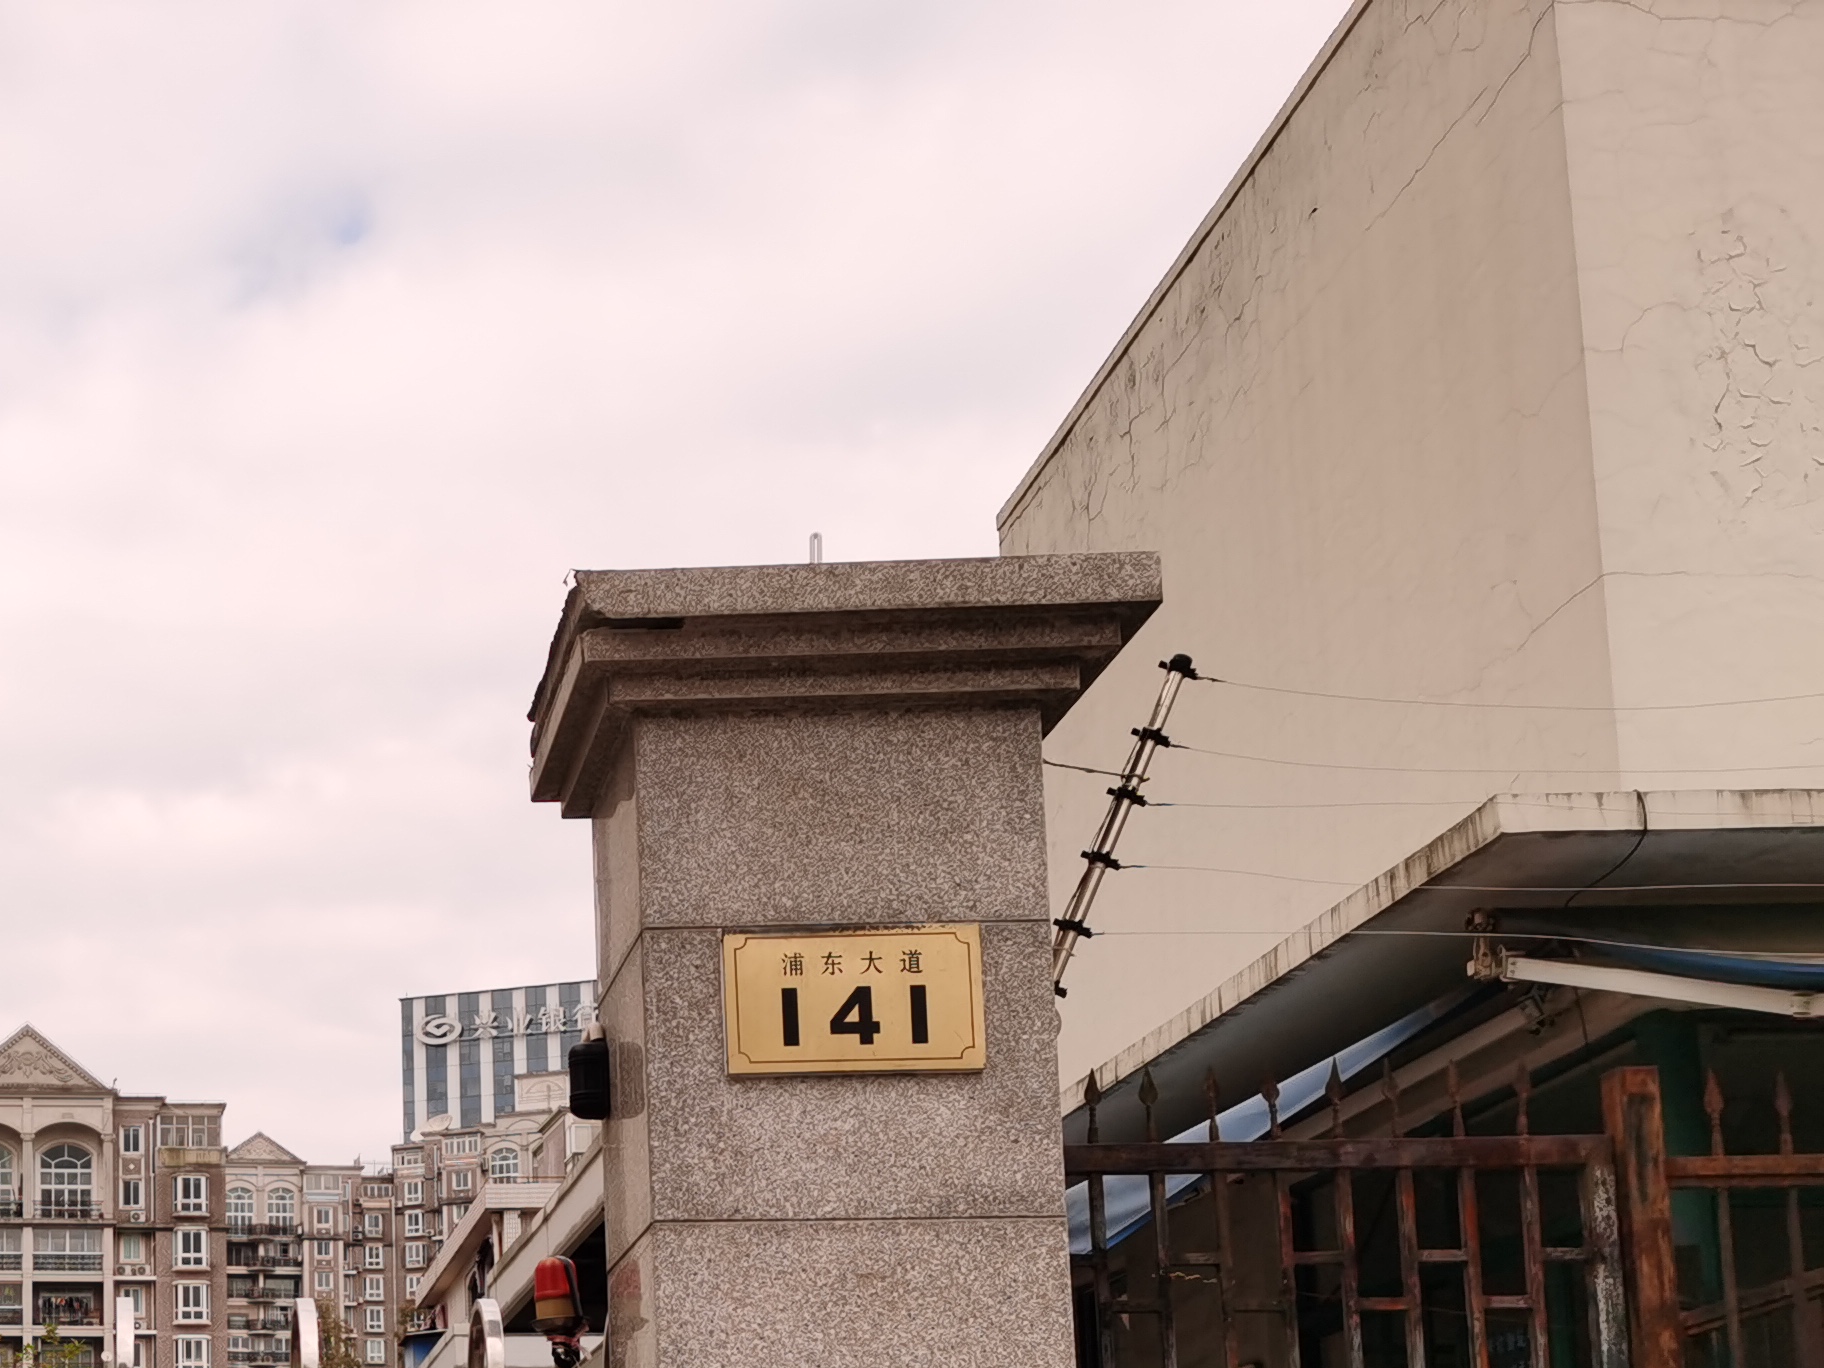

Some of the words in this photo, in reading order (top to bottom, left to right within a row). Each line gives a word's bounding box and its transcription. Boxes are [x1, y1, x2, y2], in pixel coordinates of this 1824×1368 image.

[781, 949, 924, 977] 浦东大道
[470, 1002, 599, 1039] 兴业银行
[781, 984, 929, 1046] 141
